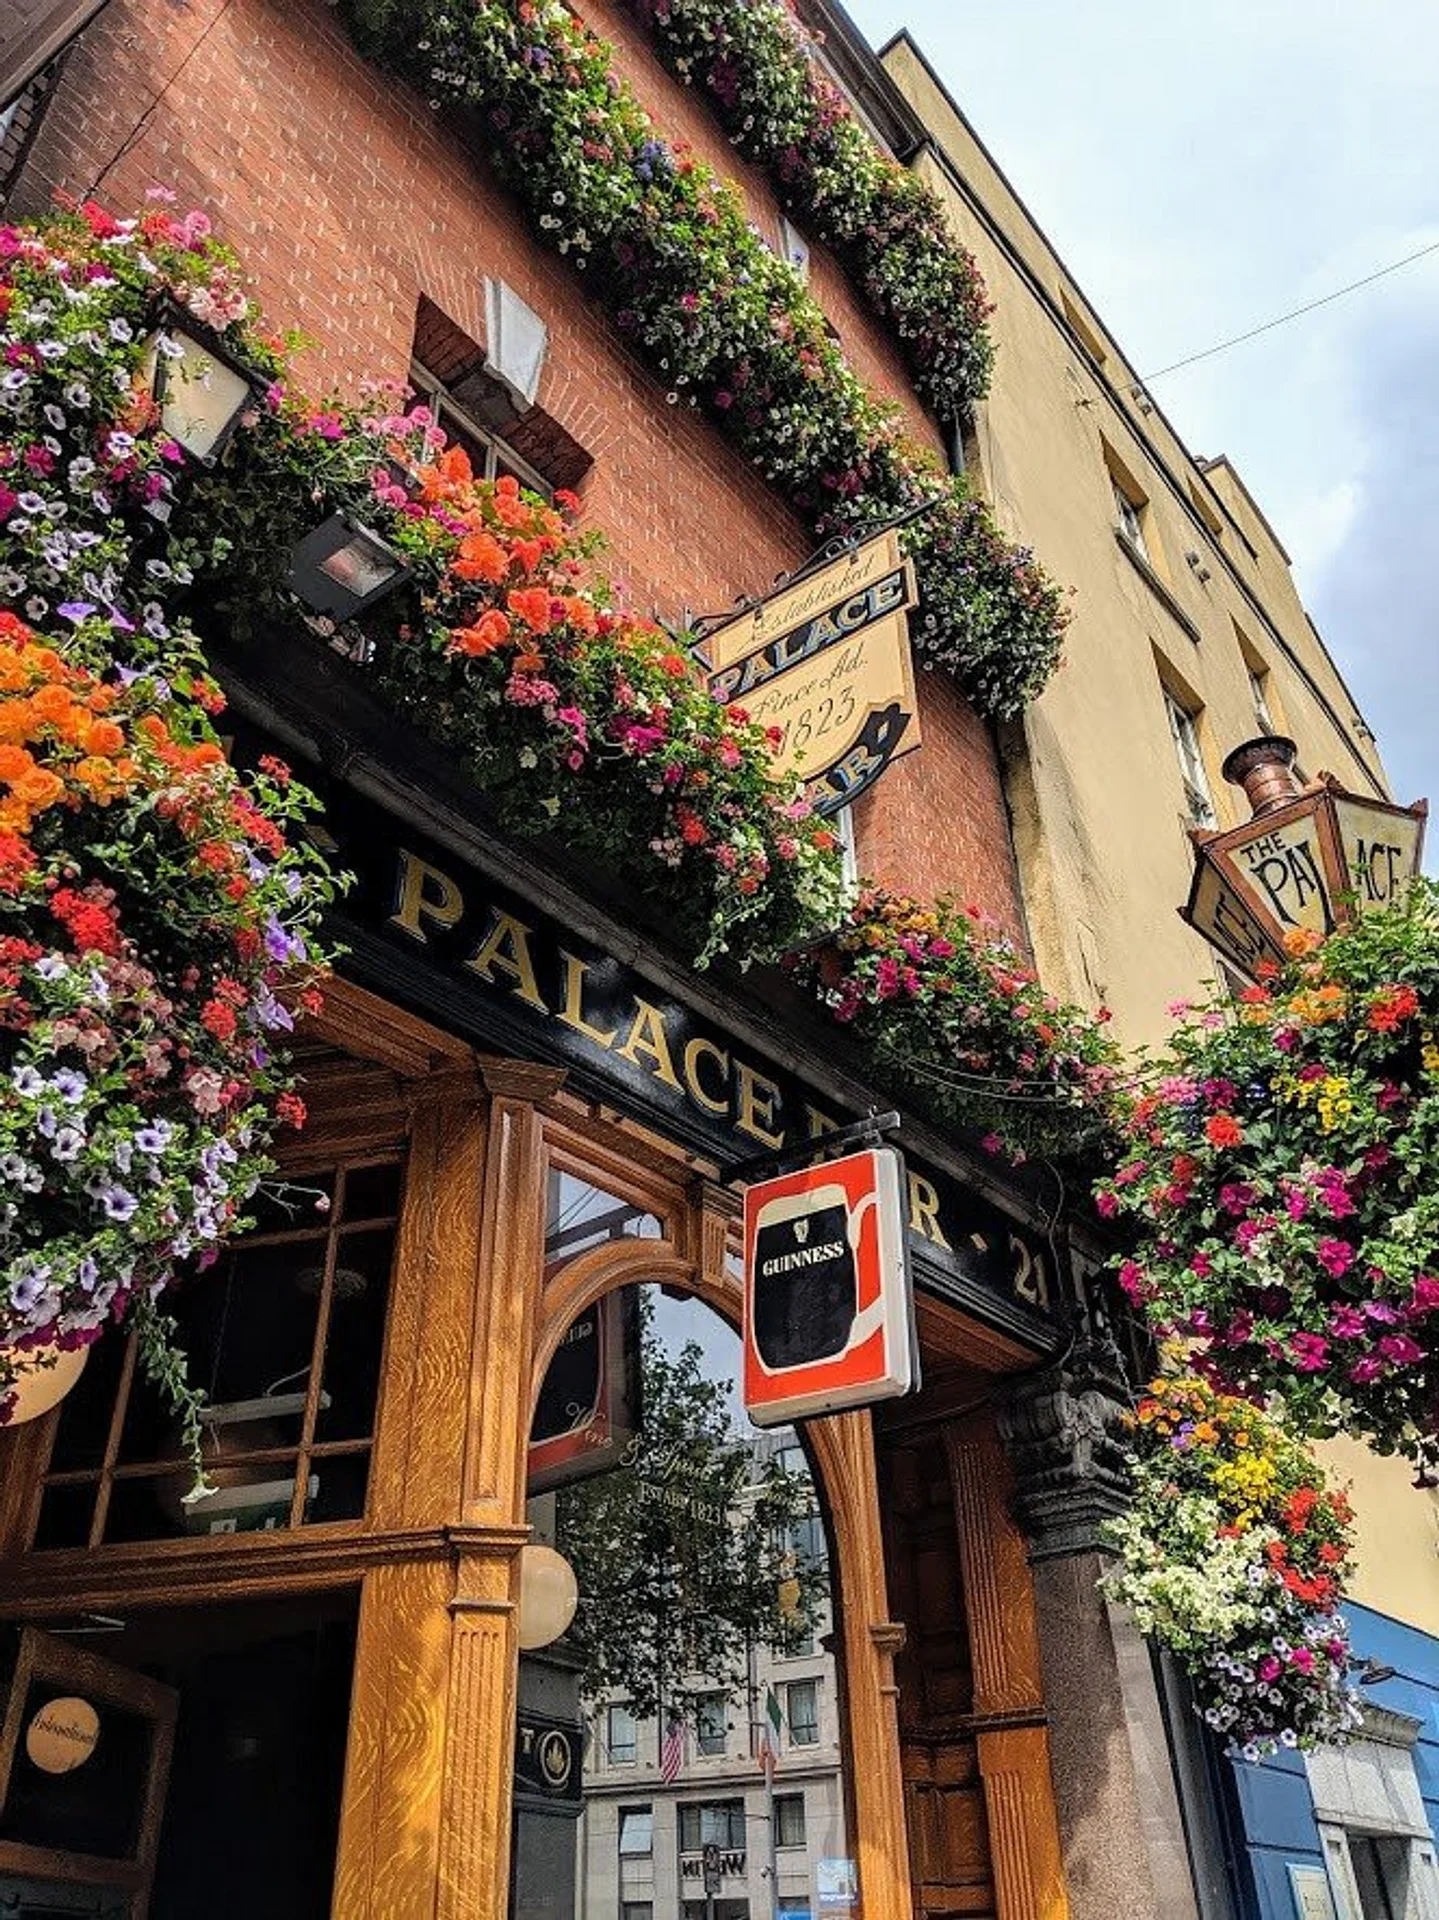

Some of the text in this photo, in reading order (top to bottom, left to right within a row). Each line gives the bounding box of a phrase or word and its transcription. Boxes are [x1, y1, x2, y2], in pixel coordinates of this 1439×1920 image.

[712, 574, 901, 694] PALACE
[744, 553, 875, 645] Established
[780, 685, 855, 756] 1823
[808, 745, 883, 804] AR
[1240, 832, 1286, 863] THE
[390, 847, 785, 1150] PALACE
[762, 1241, 844, 1277] GUINNESS
